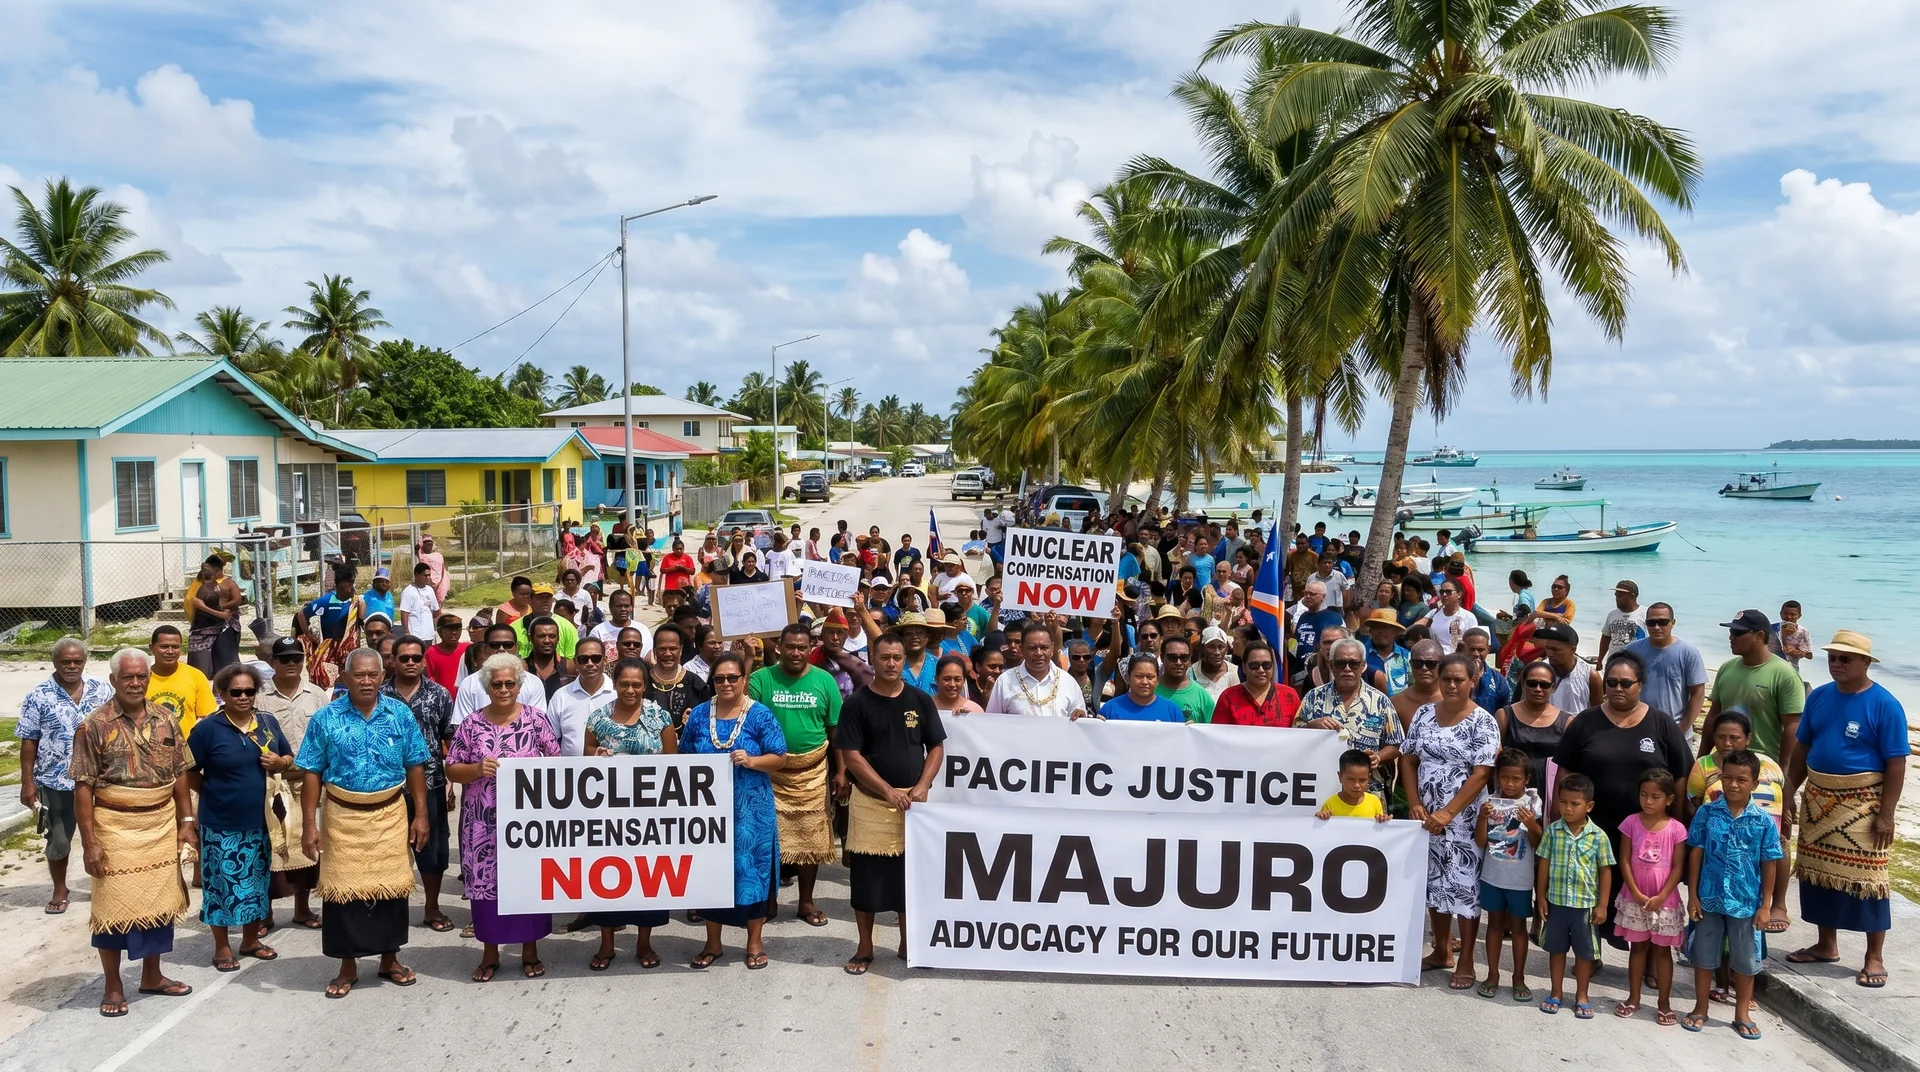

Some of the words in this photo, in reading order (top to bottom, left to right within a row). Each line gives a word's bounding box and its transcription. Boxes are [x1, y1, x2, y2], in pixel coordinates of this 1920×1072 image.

[1011, 534, 1115, 564] NUCLEAR
[1007, 562, 1115, 584] COMPENSATION
[1017, 581, 1101, 611] NOW
[515, 766, 717, 810] NUCLEAR
[945, 755, 1114, 797] PACIFIC
[1128, 765, 1318, 807] JUSTICE
[505, 817, 727, 848] COMPENSATION
[541, 855, 694, 900] NOW
[944, 831, 1389, 914] MAJURO
[929, 919, 1107, 954] ADVOCACY
[1118, 926, 1180, 957] FOR
[1191, 929, 1260, 960] OUR
[1271, 932, 1396, 963] FUTURE
